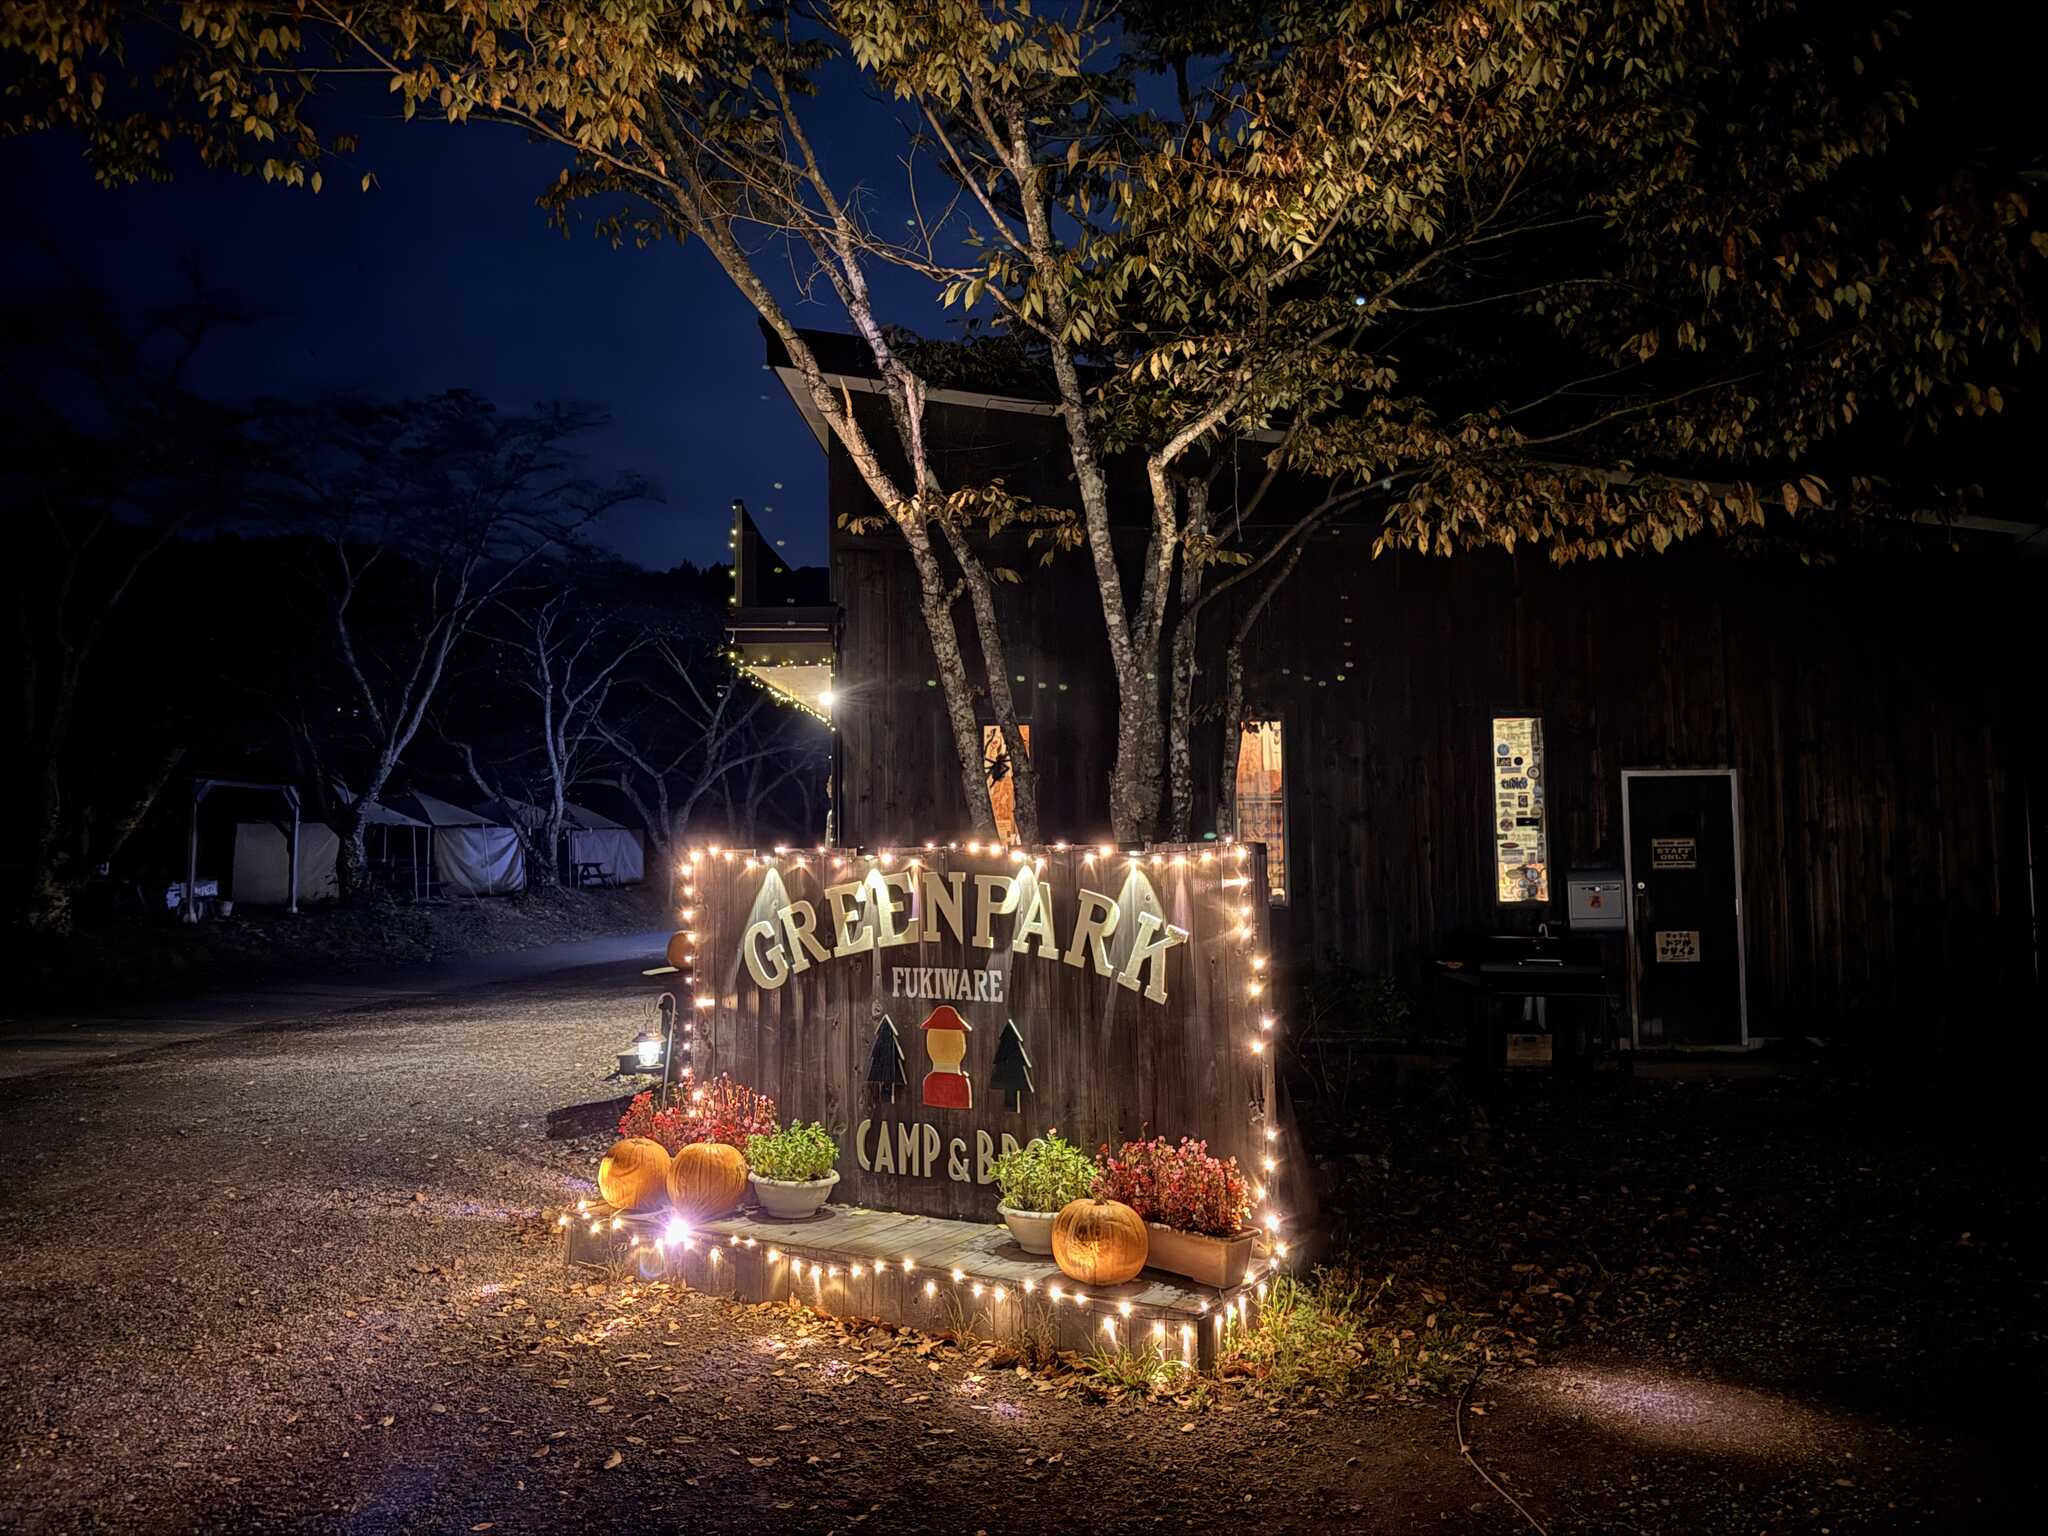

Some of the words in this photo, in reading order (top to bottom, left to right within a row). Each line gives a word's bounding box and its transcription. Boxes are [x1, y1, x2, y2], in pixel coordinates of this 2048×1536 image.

[744, 871, 1189, 1004] GREENPARK
[892, 967, 1003, 1002] FUKIWARE
[856, 1119, 941, 1178] CAMP
[947, 1137, 971, 1183] &
